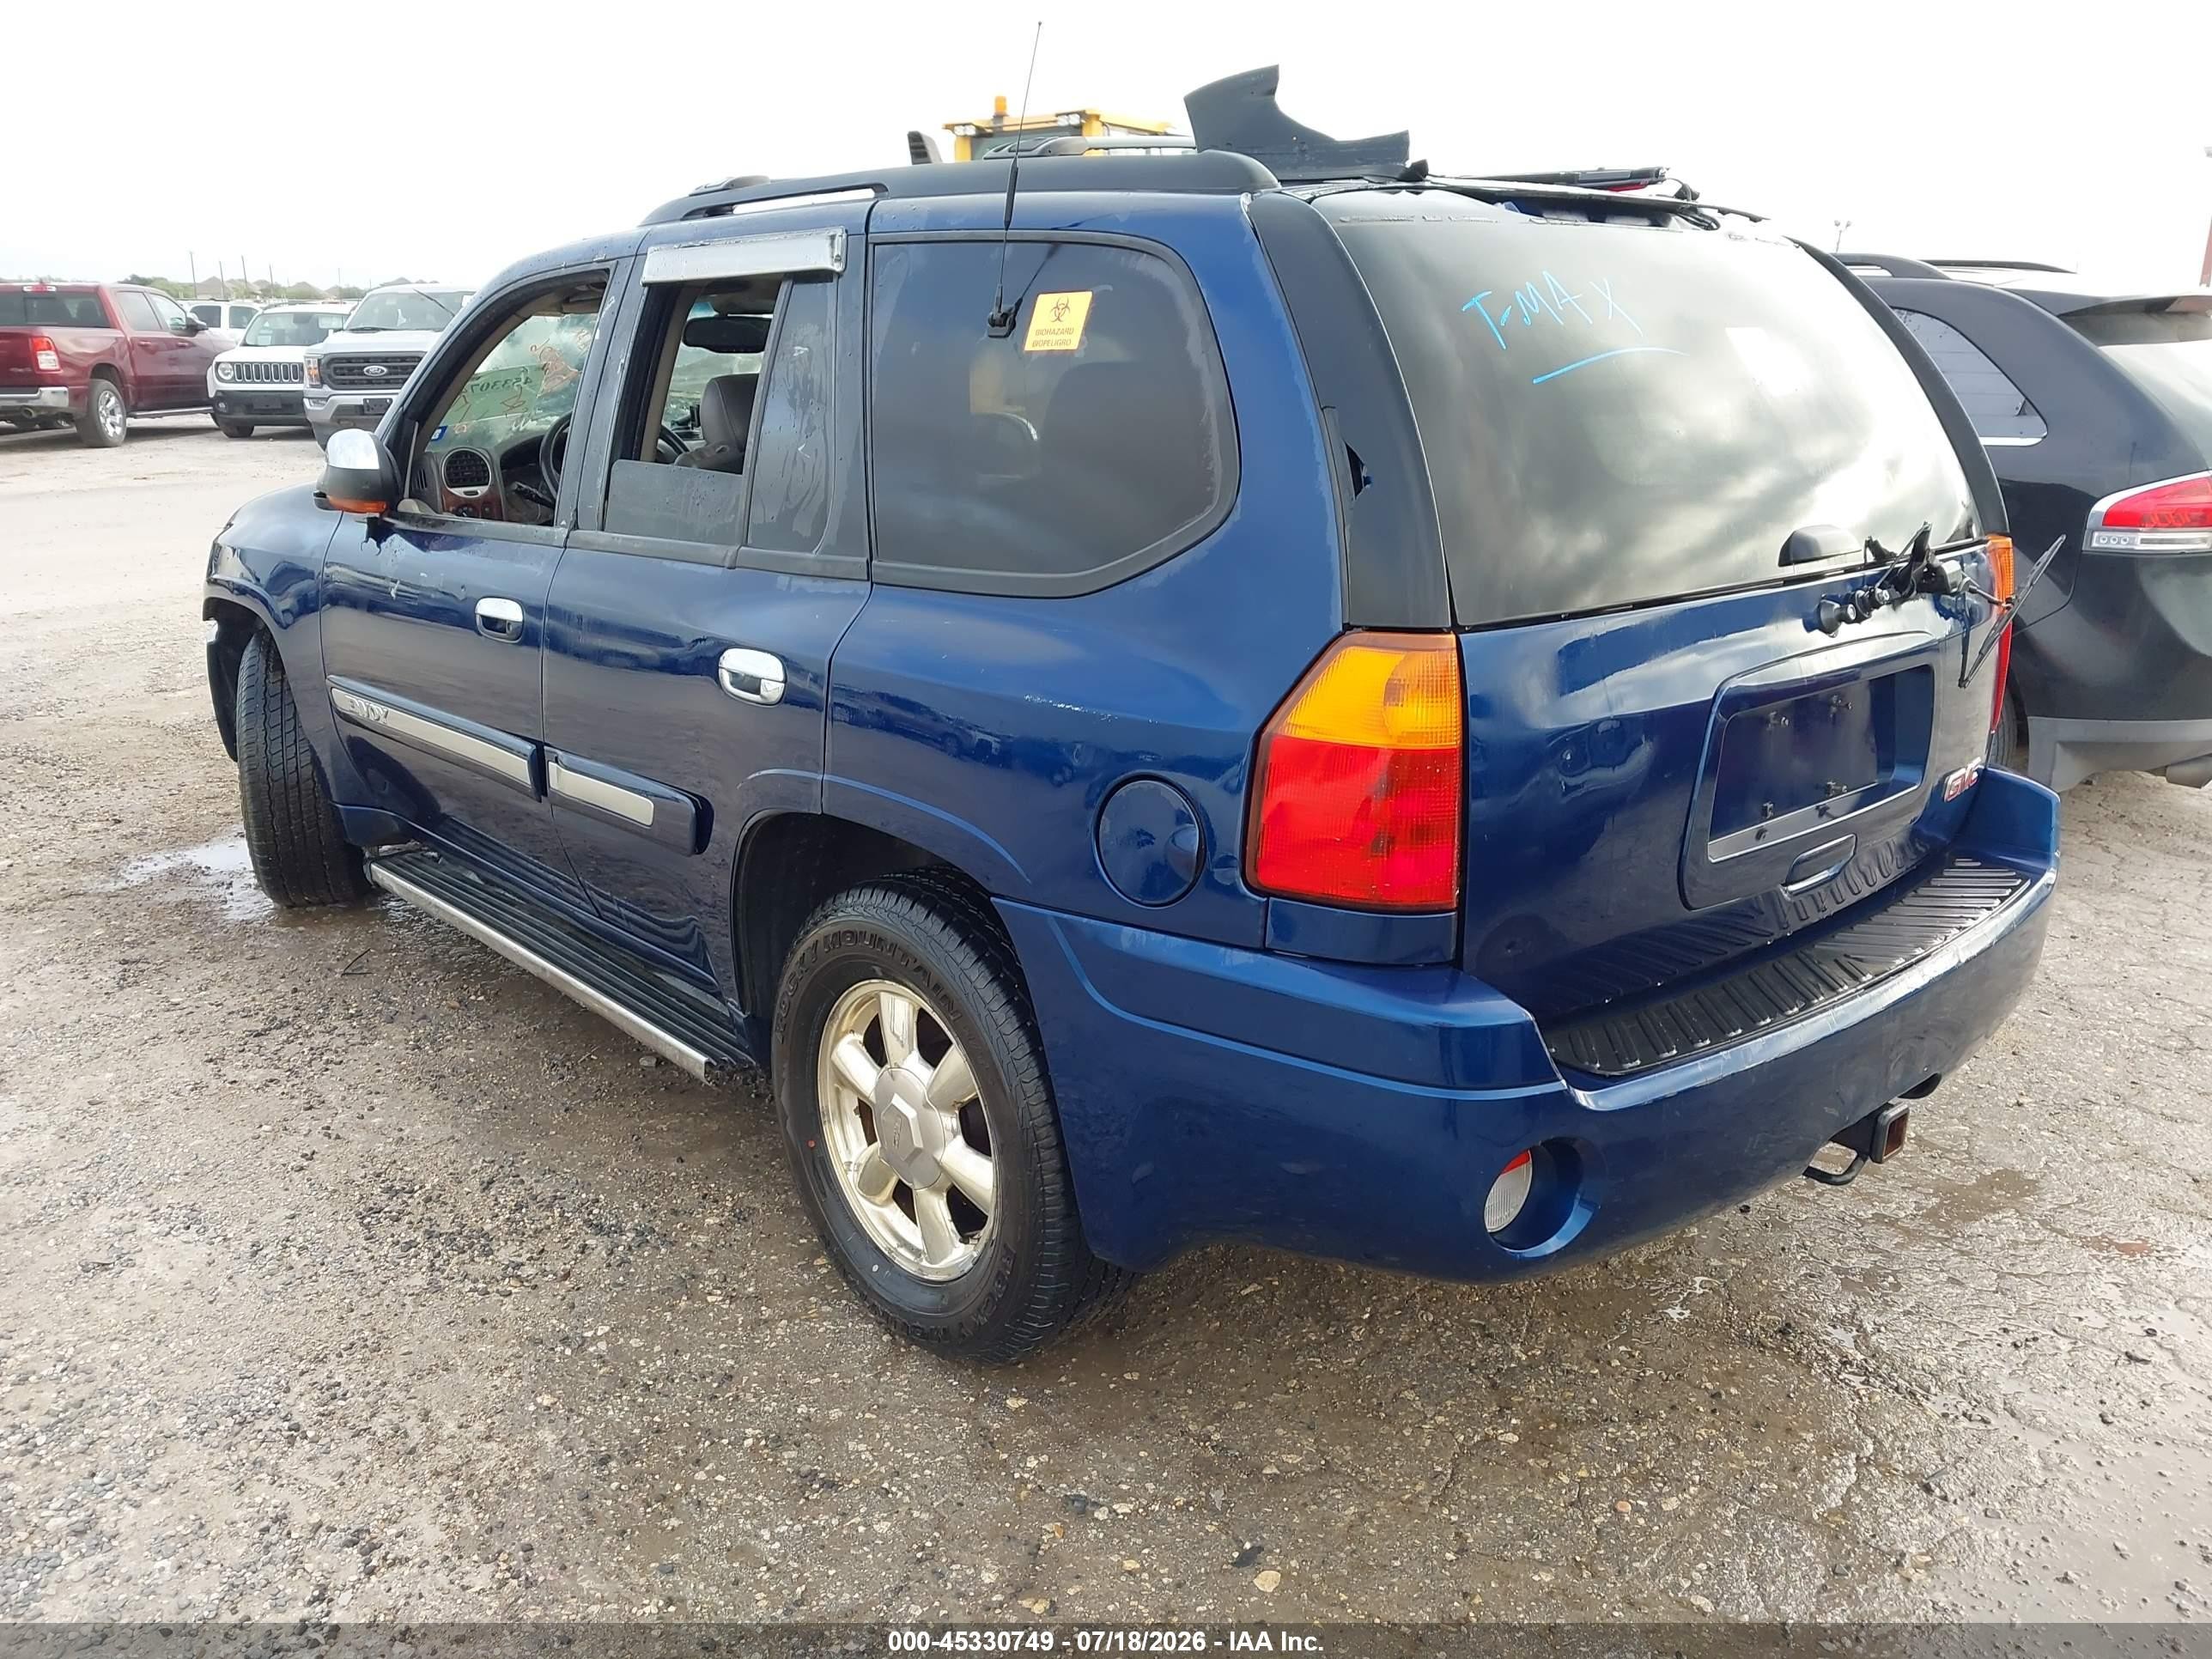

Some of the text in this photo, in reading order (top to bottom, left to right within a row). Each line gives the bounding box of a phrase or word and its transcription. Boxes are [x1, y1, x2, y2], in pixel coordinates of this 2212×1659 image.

[1035, 327, 1075, 337] BIOHAZARD
[1944, 757, 1981, 802] GMC
[823, 929, 963, 1023] MOUNTAIN
